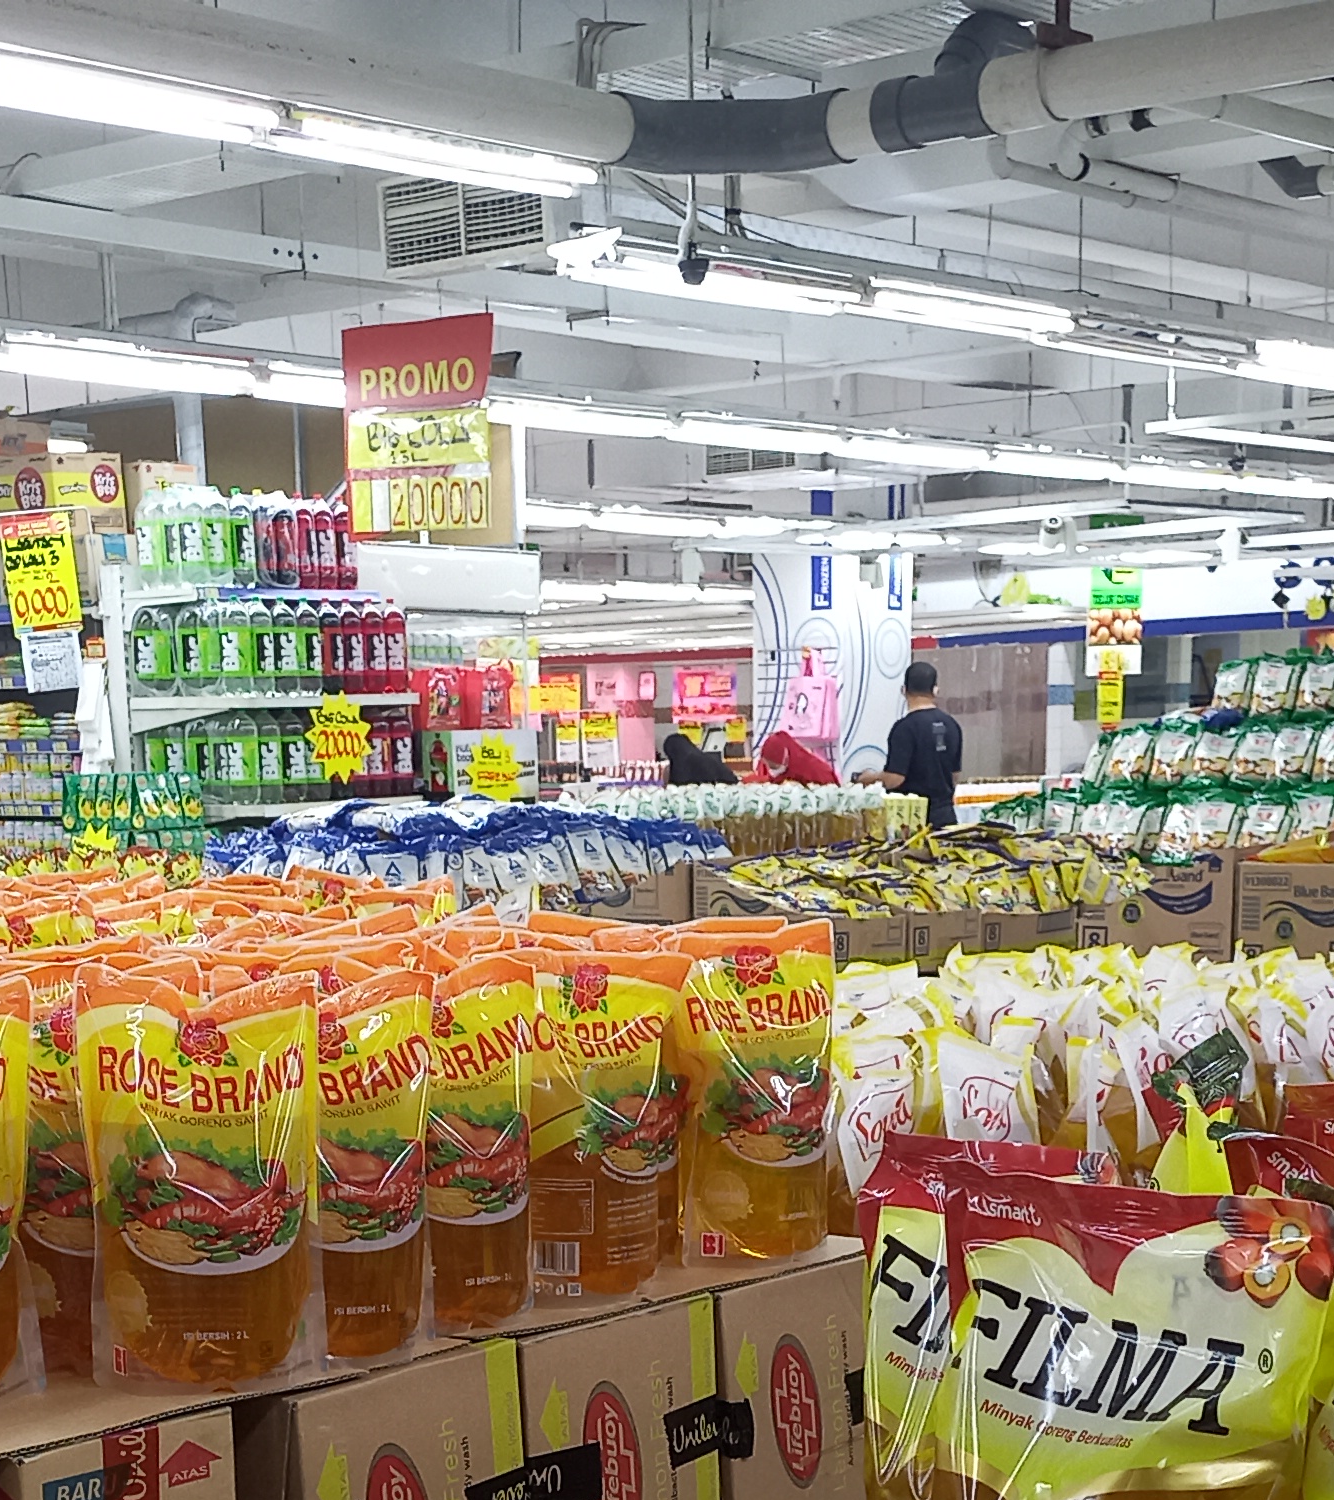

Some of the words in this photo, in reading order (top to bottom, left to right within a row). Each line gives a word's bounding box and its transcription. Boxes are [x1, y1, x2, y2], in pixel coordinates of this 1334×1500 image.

[360, 357, 475, 401] PROMO
[18, 478, 43, 496] Kris
[20, 493, 43, 510] Bee
[94, 471, 115, 488] Kris
[96, 484, 116, 498] Bee
[393, 475, 486, 529] 20.000
[815, 556, 831, 609] FROZEN
[1294, 884, 1319, 898] Blue
[575, 1012, 665, 1064] BRAND
[687, 994, 743, 1039] ROSE
[97, 1044, 177, 1114] ROSE
[189, 1047, 306, 1114] BRAND
[318, 1035, 432, 1107] BRAND
[178, 1112, 234, 1130] GORENG
[987, 1200, 1035, 1226] smart
[972, 1277, 1244, 1438] FILMA
[784, 1353, 804, 1472] Lifebuoy
[979, 1398, 1033, 1430] Minyak
[1036, 1414, 1078, 1443] Goreng
